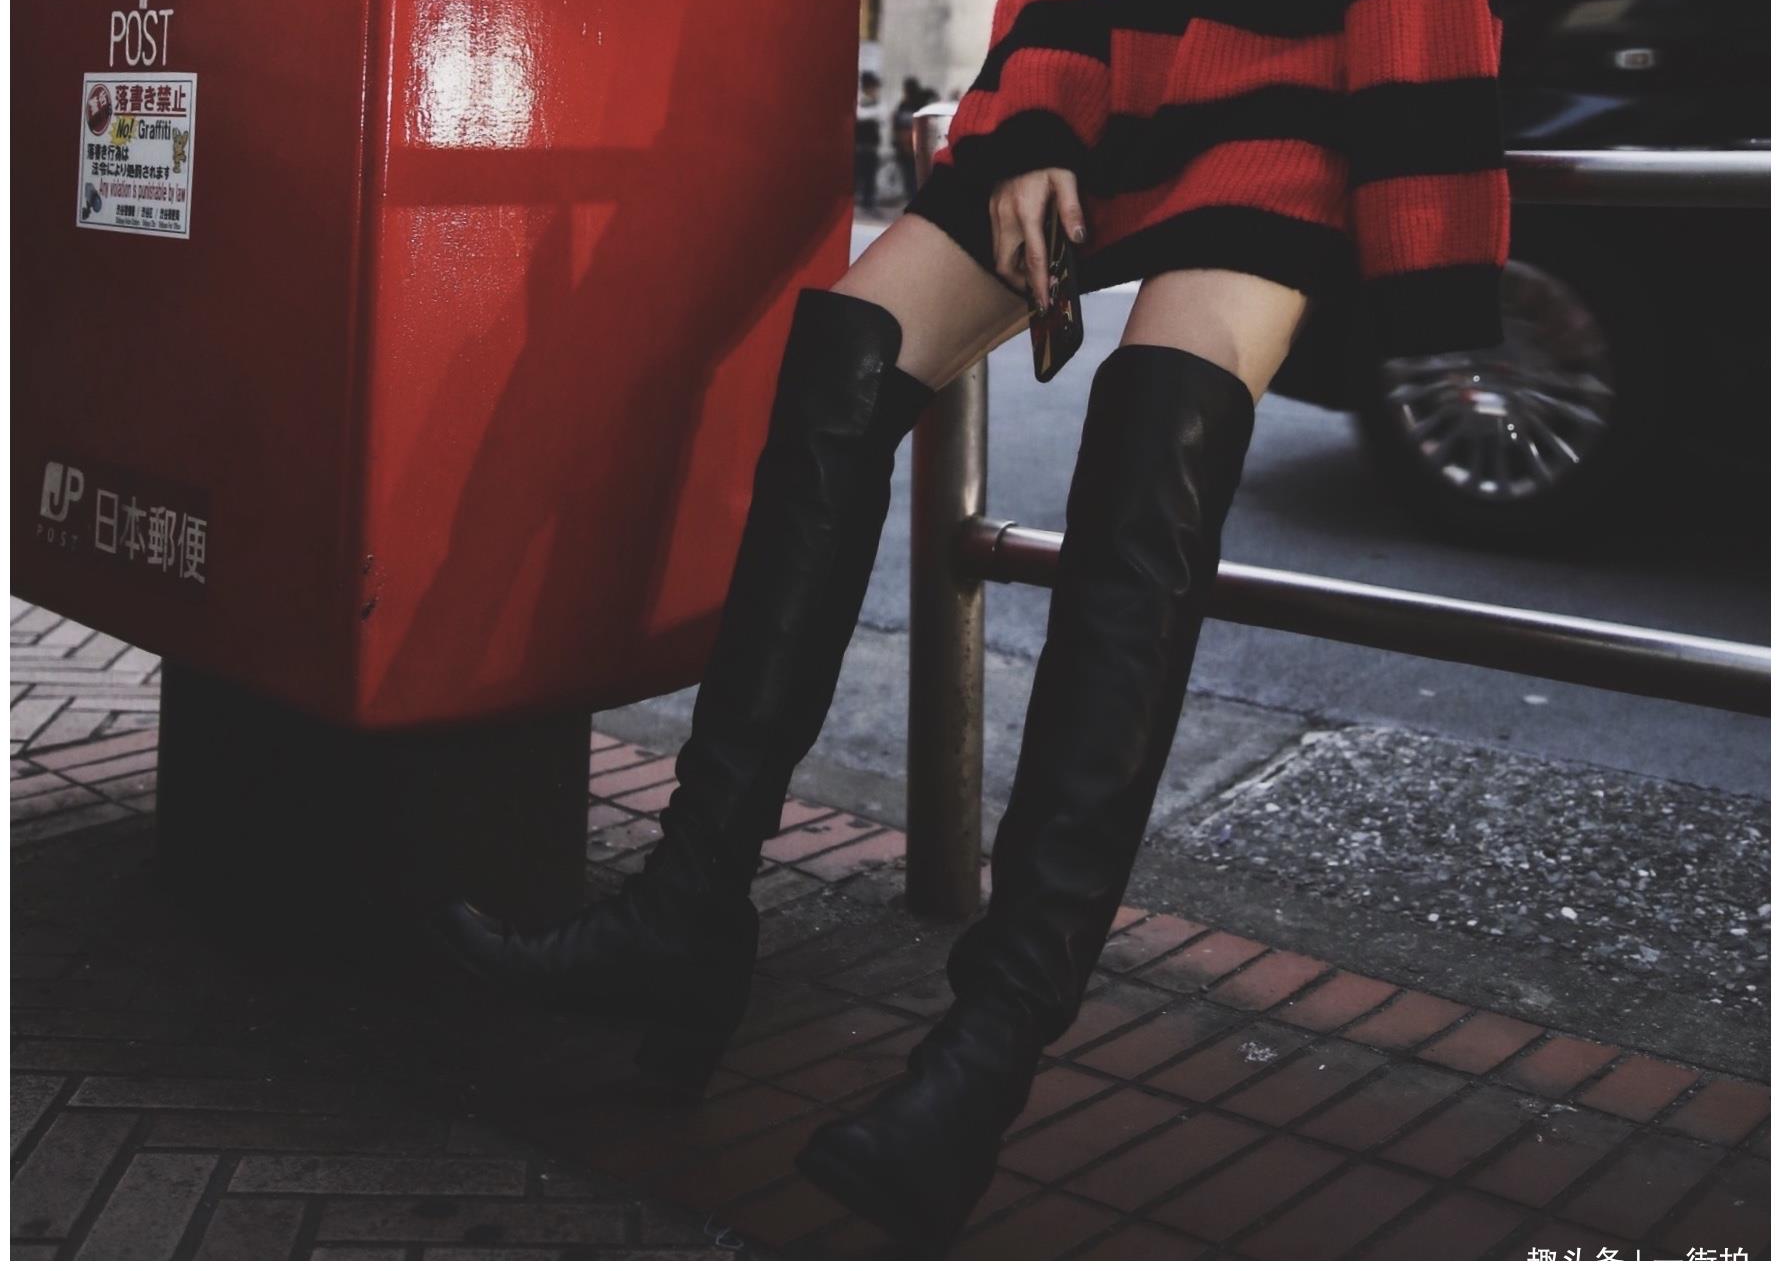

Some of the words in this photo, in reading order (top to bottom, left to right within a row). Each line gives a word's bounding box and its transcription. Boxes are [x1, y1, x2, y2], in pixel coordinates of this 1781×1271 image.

[109, 8, 174, 67] POST
[114, 84, 187, 112] 落書き禁止
[116, 118, 134, 139] No!
[138, 119, 171, 140] Graffiti
[40, 461, 84, 522] JP
[95, 488, 207, 585] 日本郵便
